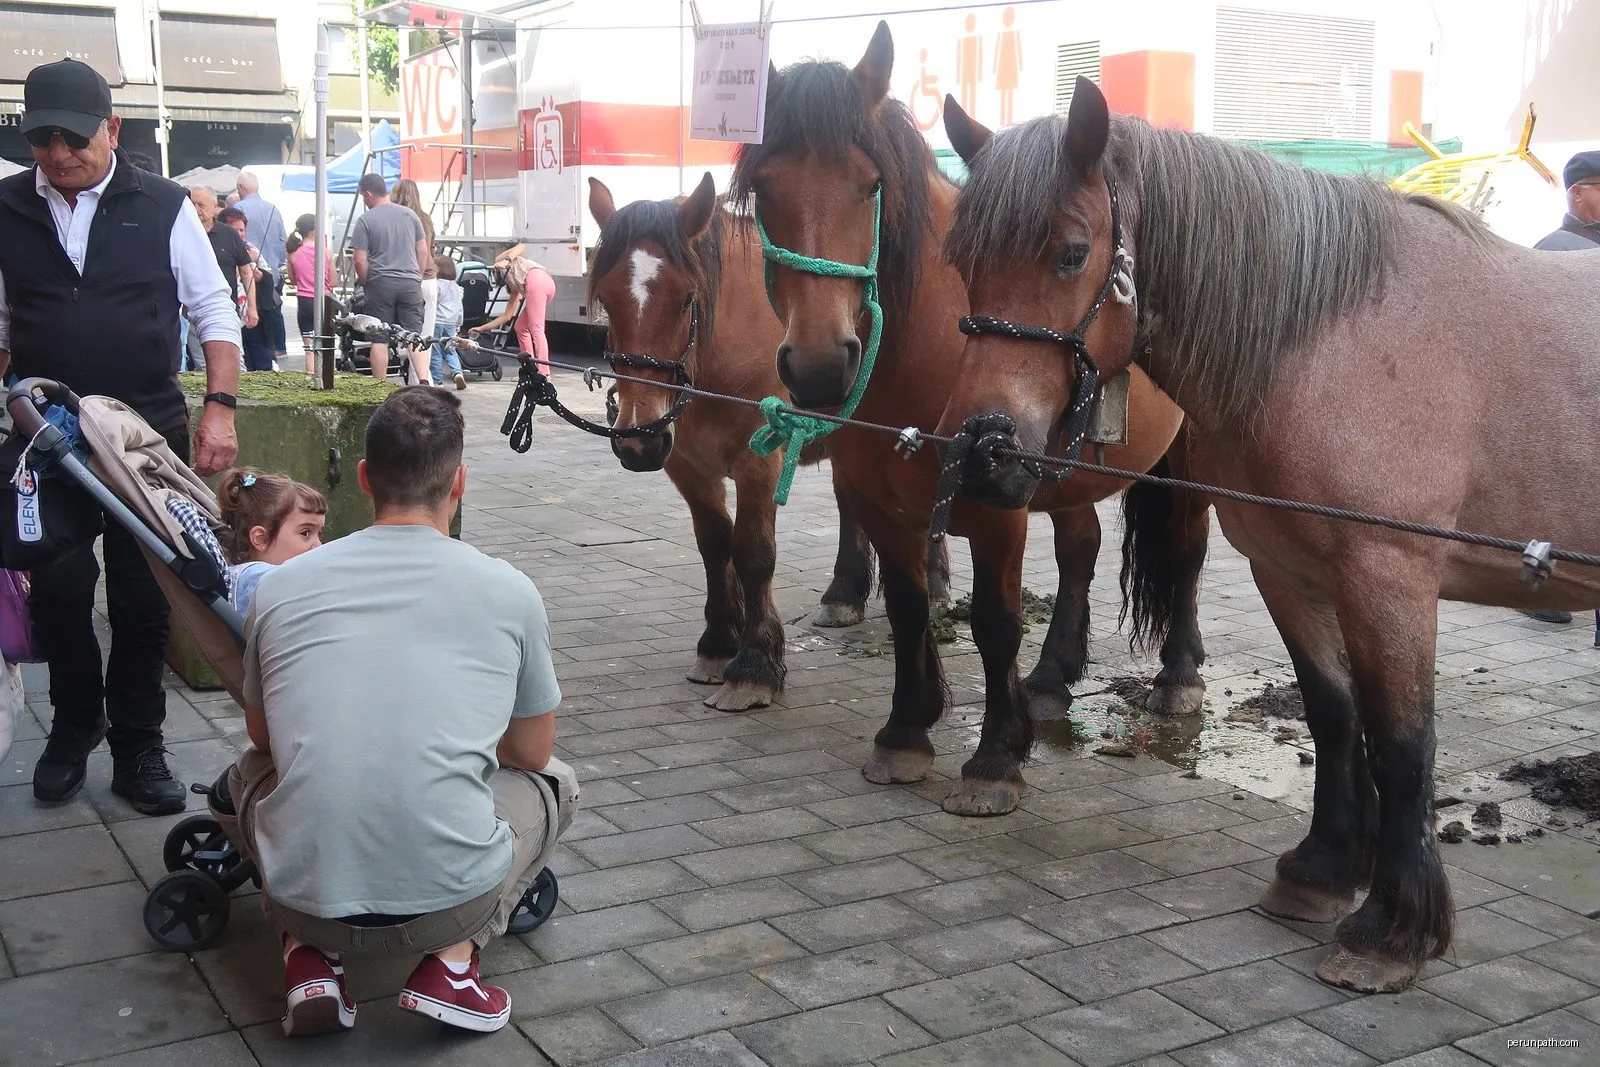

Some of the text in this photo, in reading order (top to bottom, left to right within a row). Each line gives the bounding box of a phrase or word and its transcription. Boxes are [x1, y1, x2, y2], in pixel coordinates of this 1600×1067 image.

[14, 48, 44, 56] café
[66, 50, 89, 59] bar
[183, 56, 212, 65] café
[231, 57, 254, 66] bar
[402, 64, 457, 137] WC
[207, 122, 238, 131] plaza
